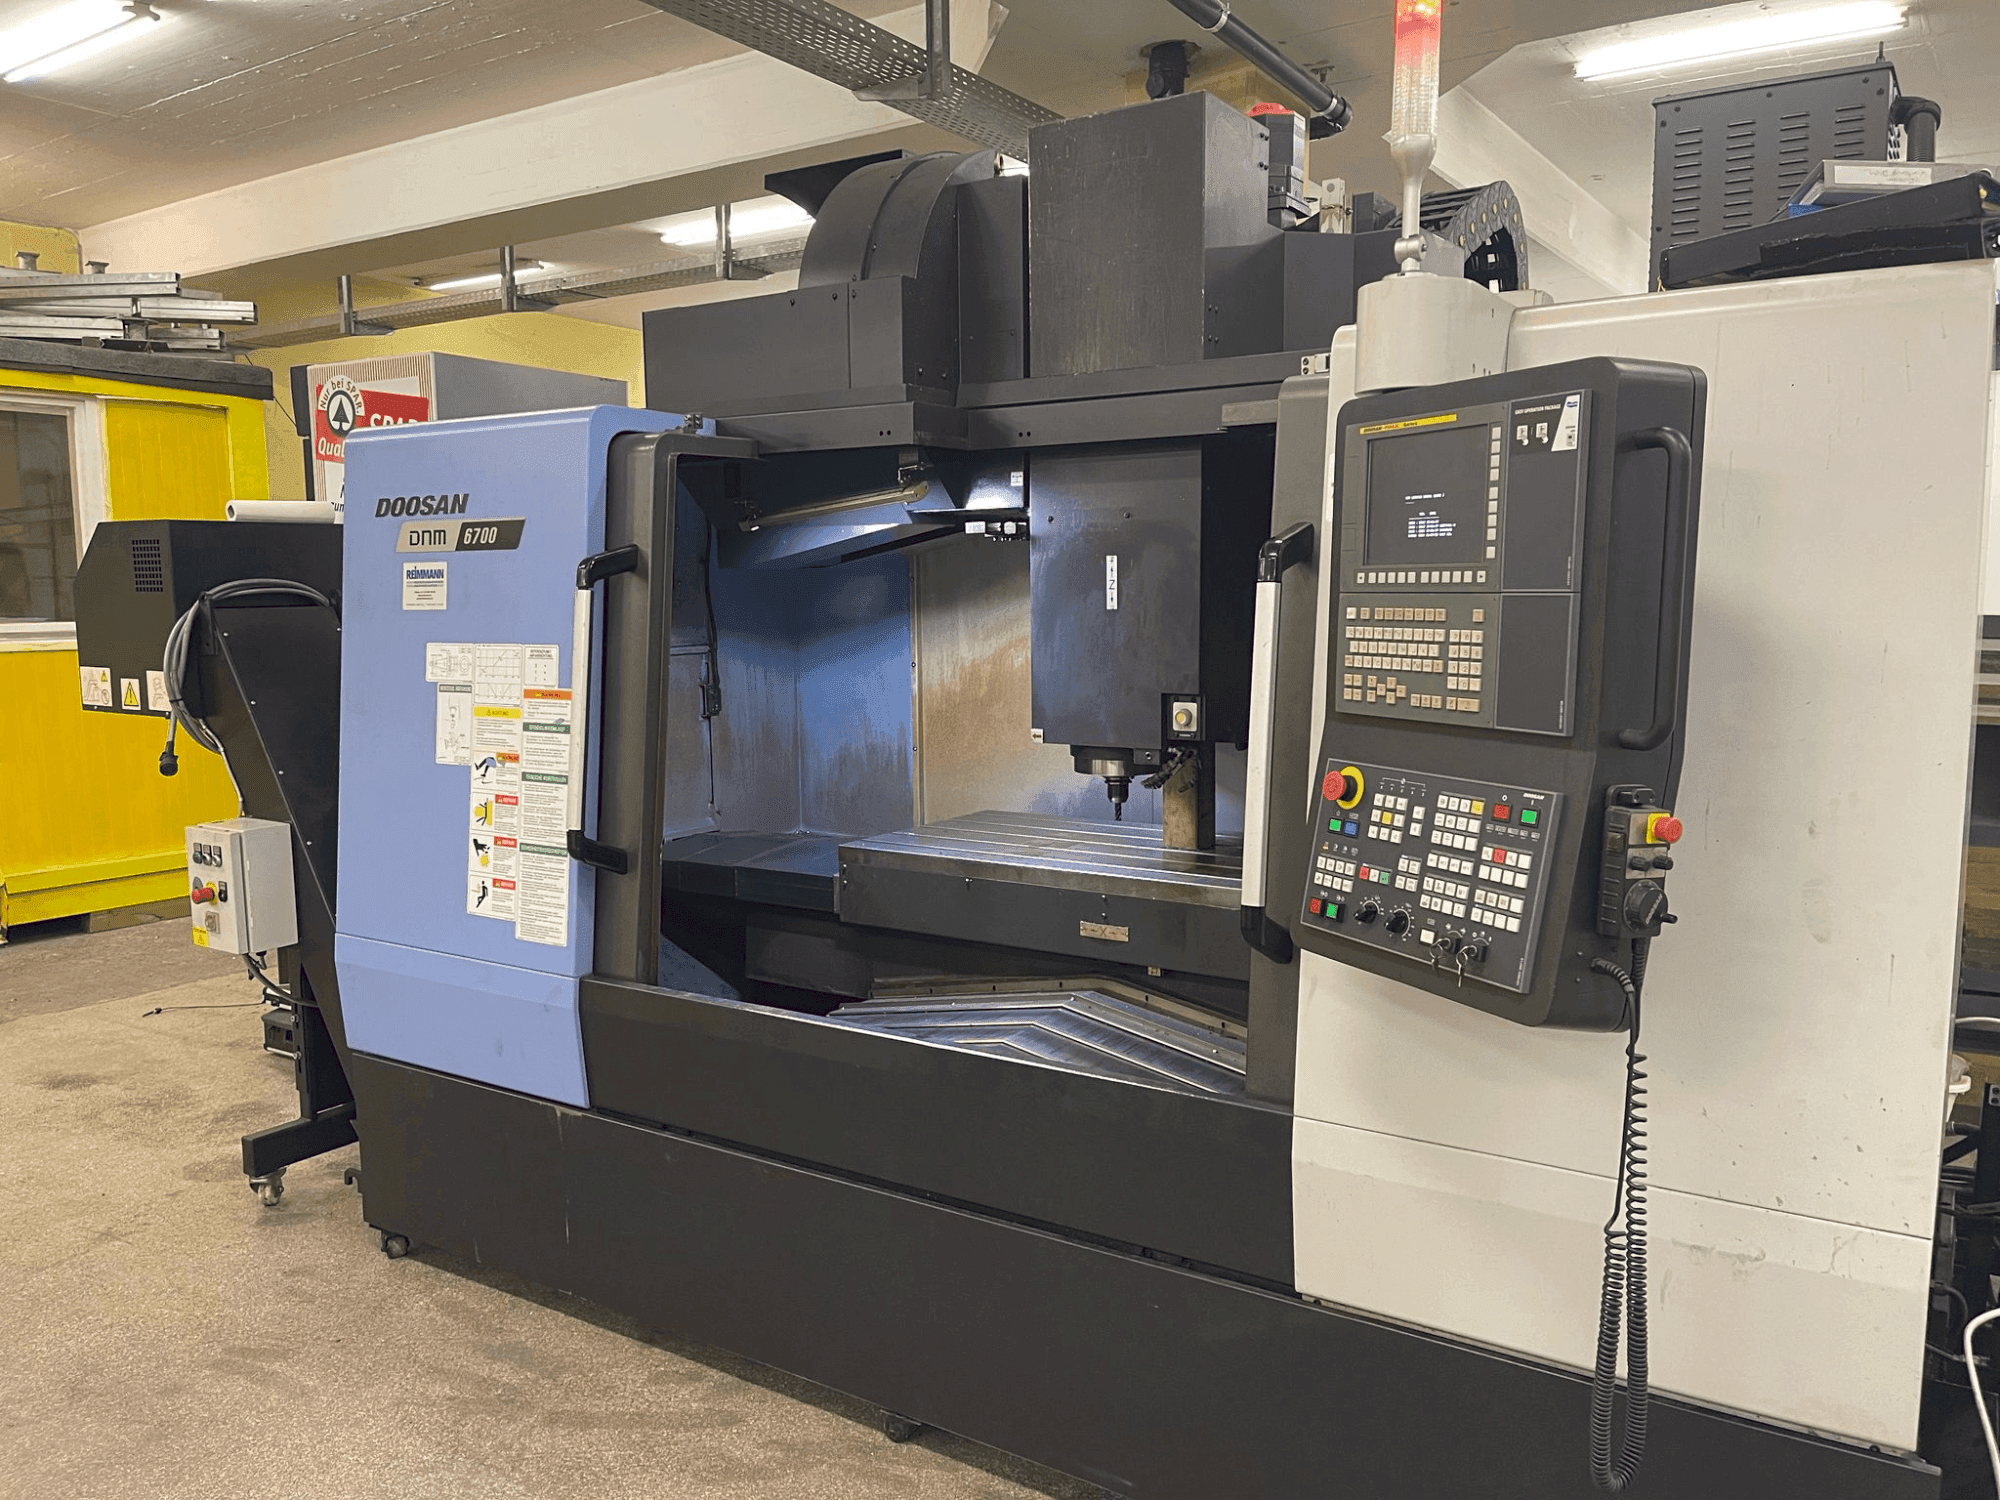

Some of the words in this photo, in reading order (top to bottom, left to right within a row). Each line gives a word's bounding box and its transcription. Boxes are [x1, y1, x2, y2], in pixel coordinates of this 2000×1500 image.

[319, 388, 331, 409] Nur
[331, 378, 344, 390] bei
[375, 493, 470, 518] DOOSAN
[463, 526, 498, 545] 6700
